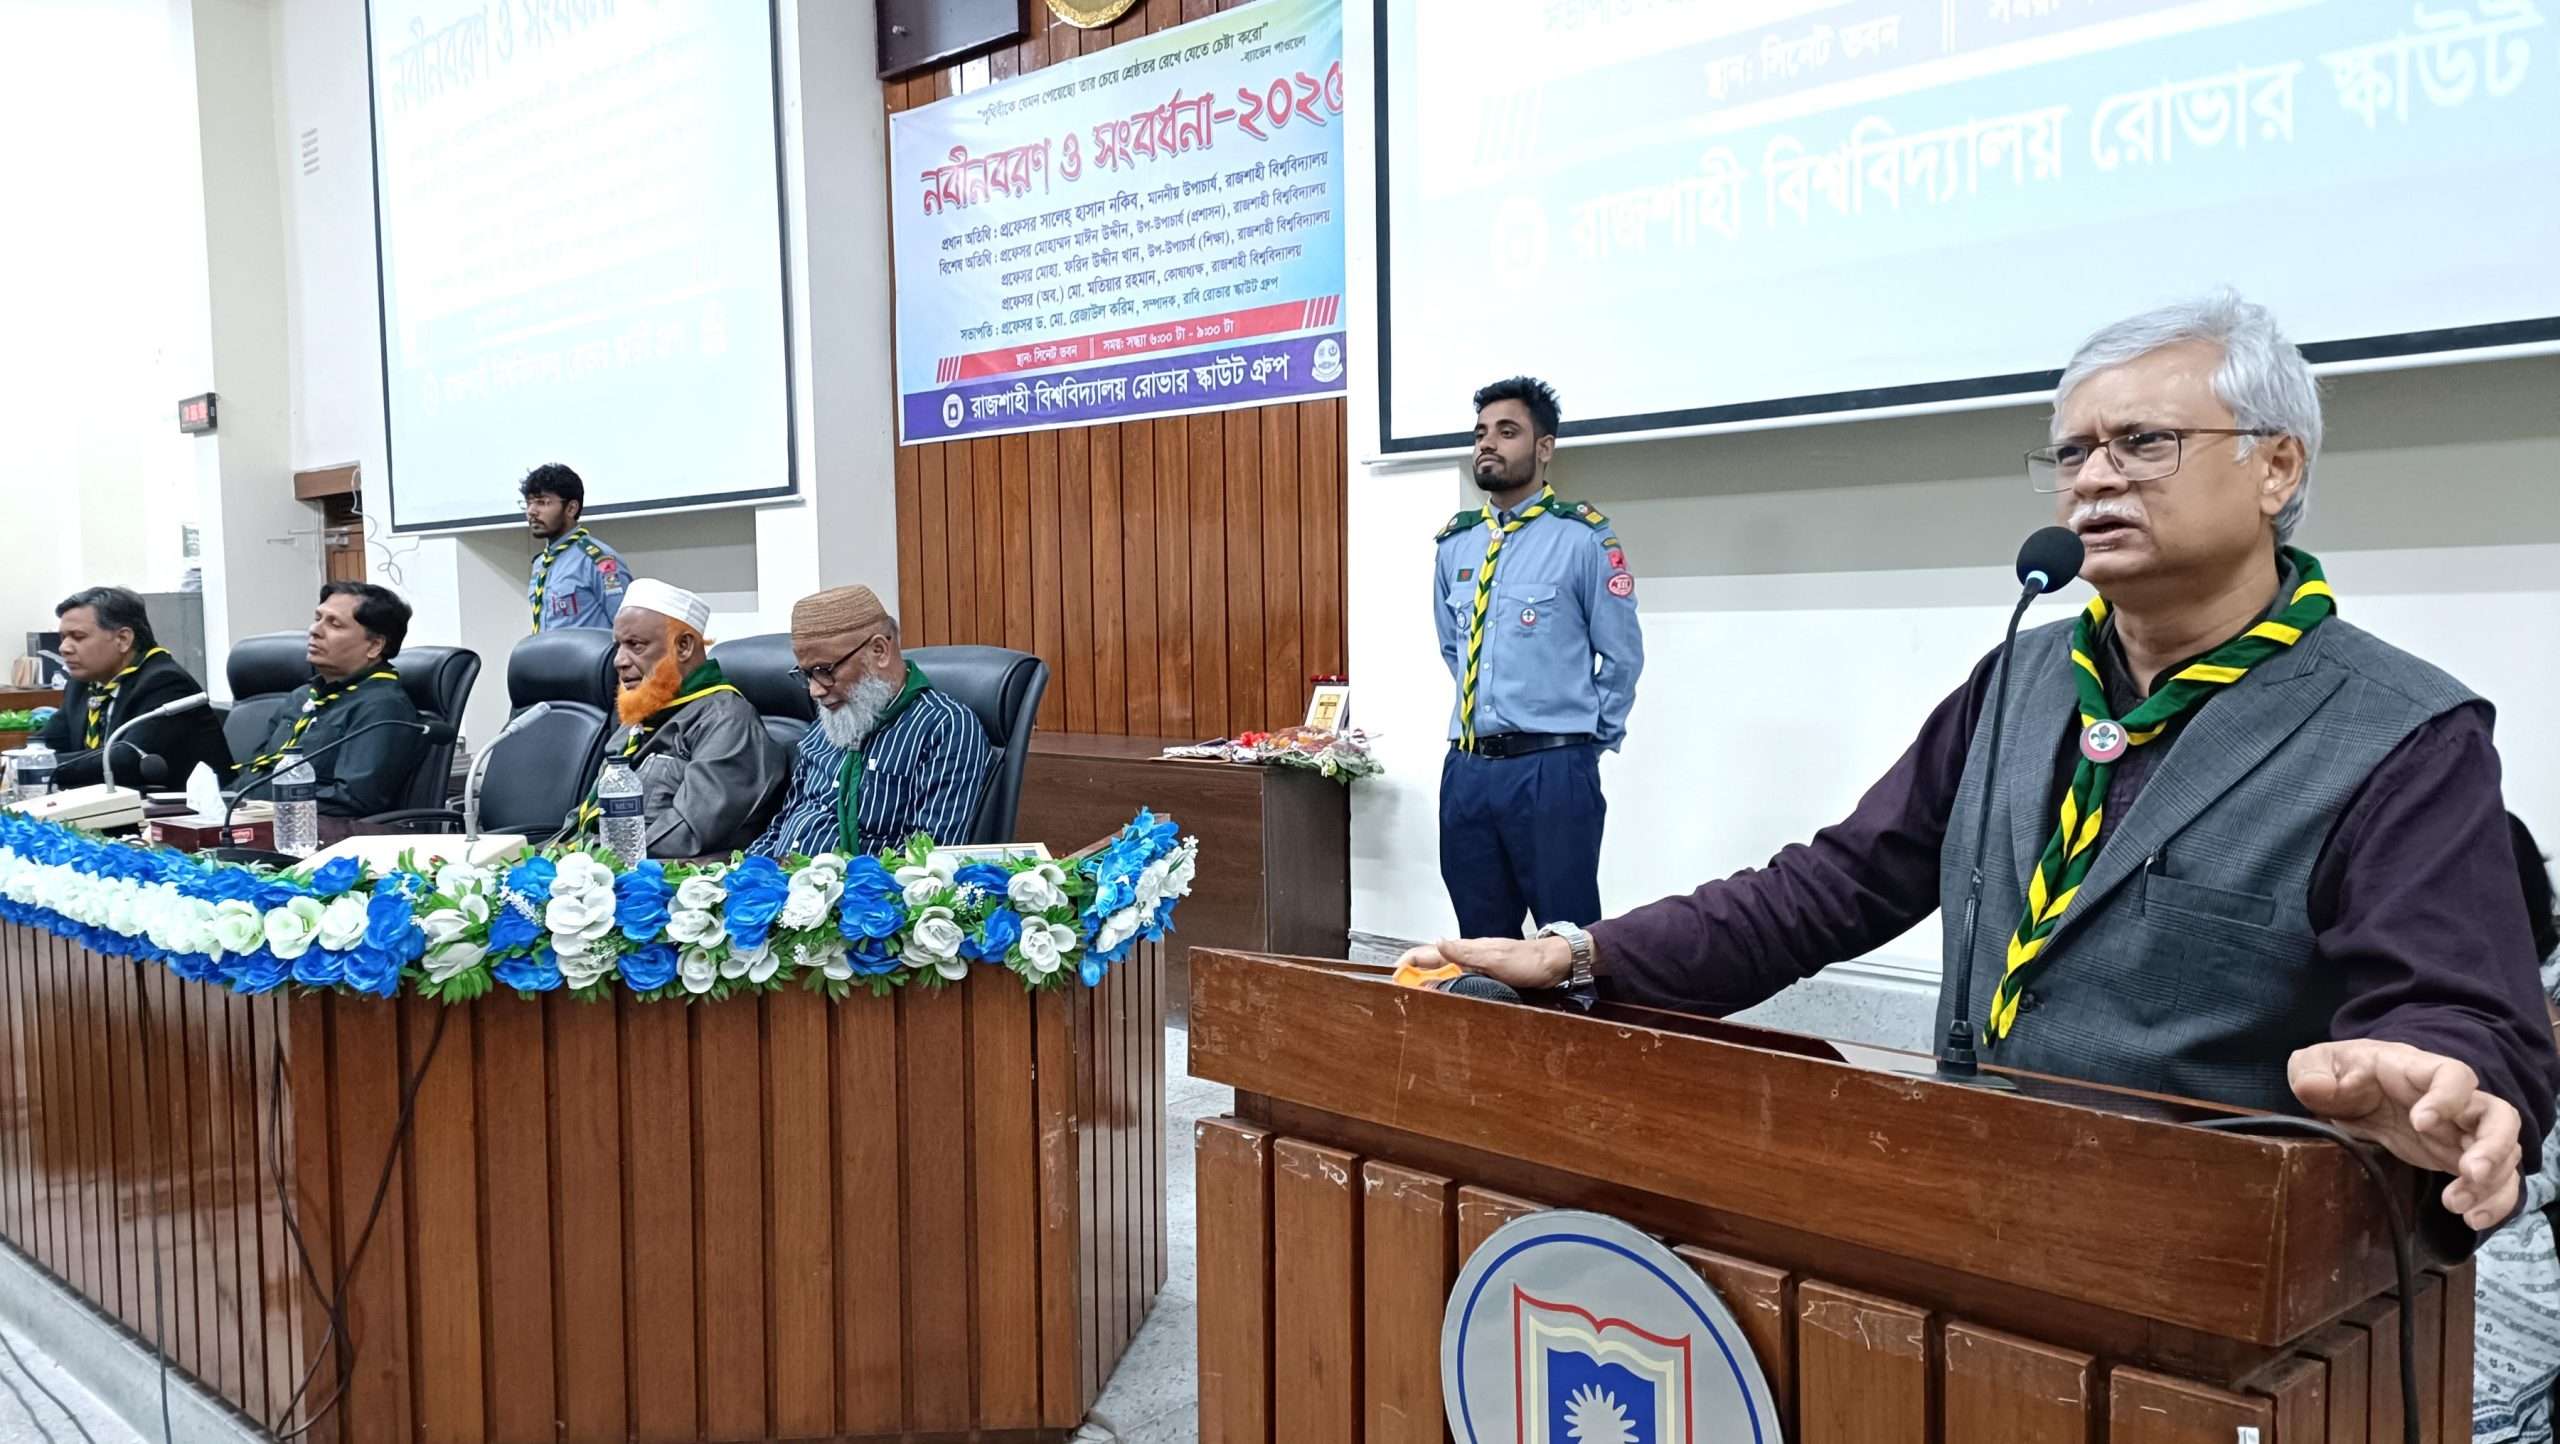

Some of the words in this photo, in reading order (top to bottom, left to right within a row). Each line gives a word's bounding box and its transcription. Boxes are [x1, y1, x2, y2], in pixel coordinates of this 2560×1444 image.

[1078, 76, 1096, 93] তার
[1098, 69, 1120, 88] চেয়ে
[1122, 58, 1156, 81] শ্রেষ্ঠতর
[1159, 52, 1182, 70] রেখে
[1184, 42, 1210, 62] যেতে
[1212, 33, 1234, 53] চেষ্টা
[1760, 22, 1835, 81] সিনেট
[1839, 14, 1902, 60] ভবন
[1568, 145, 1751, 259] রাজশাহী
[1761, 104, 2072, 230] বিশ্ববিদ্যালয়
[2090, 59, 2304, 172] রোভার
[2320, 0, 2545, 130] স্কাউট
[920, 137, 1051, 216] নবীনবরণ
[1060, 132, 1082, 182] ও
[941, 235, 963, 250] প্রধান
[965, 225, 992, 245] অতিথি
[1000, 216, 1037, 238] প্রফেসর
[1075, 200, 1105, 221] হাসান
[1147, 183, 1180, 205] মাননীয়
[1225, 161, 1266, 187] রাজশাহী
[1269, 151, 1328, 178] বিশ্ববিদ্যালয়
[940, 258, 963, 276] বিশেষ
[965, 249, 992, 269] অতিথি
[1000, 244, 1032, 261] প্রফেসর
[1035, 236, 1072, 256] মোহাম্মদ
[1074, 228, 1098, 247] মাঈন
[1136, 209, 1185, 234] উপ-উপাচার্য
[1233, 190, 1270, 213] রাজশাহী
[1273, 182, 1327, 205] বিশ্ববিদ্যালয়
[1001, 269, 1033, 286] প্রফেসর
[1064, 254, 1089, 273] ফরিদ
[1092, 248, 1118, 268] উদ্দীন
[1147, 233, 1196, 258] উপ-উপাচার্য
[1237, 217, 1274, 240] রাজশাহী
[1277, 210, 1330, 233] বিশ্ববিদ্যালয়
[960, 321, 993, 342] সভাপতি
[1001, 317, 1033, 335] প্রফেসর
[1070, 304, 1106, 324] রেজাউল
[1183, 287, 1201, 304] রাবি
[1203, 285, 1231, 302] রোভার
[1233, 278, 1258, 296] স্কাউট
[1260, 276, 1279, 291] গ্রুপ
[1001, 293, 1033, 310] প্রফেসর
[1087, 275, 1122, 295] মতিয়ার
[1211, 250, 1247, 273] রাজশাহী
[1250, 244, 1302, 266] বিশ্ববিদ্যালয়
[1033, 346, 1057, 363] সিনেট
[1059, 344, 1078, 358] ভবন
[1125, 333, 1147, 349] সন্ধ্যা
[1175, 325, 1186, 341] টা
[1223, 317, 1234, 334] টা
[969, 382, 1030, 420] রাজশাহী
[1034, 375, 1128, 412] বিশ্ববিদ্যালয়
[1132, 367, 1190, 400] রোভার
[1192, 353, 1247, 393] স্কাউট
[1250, 352, 1291, 385] গ্রুপ
